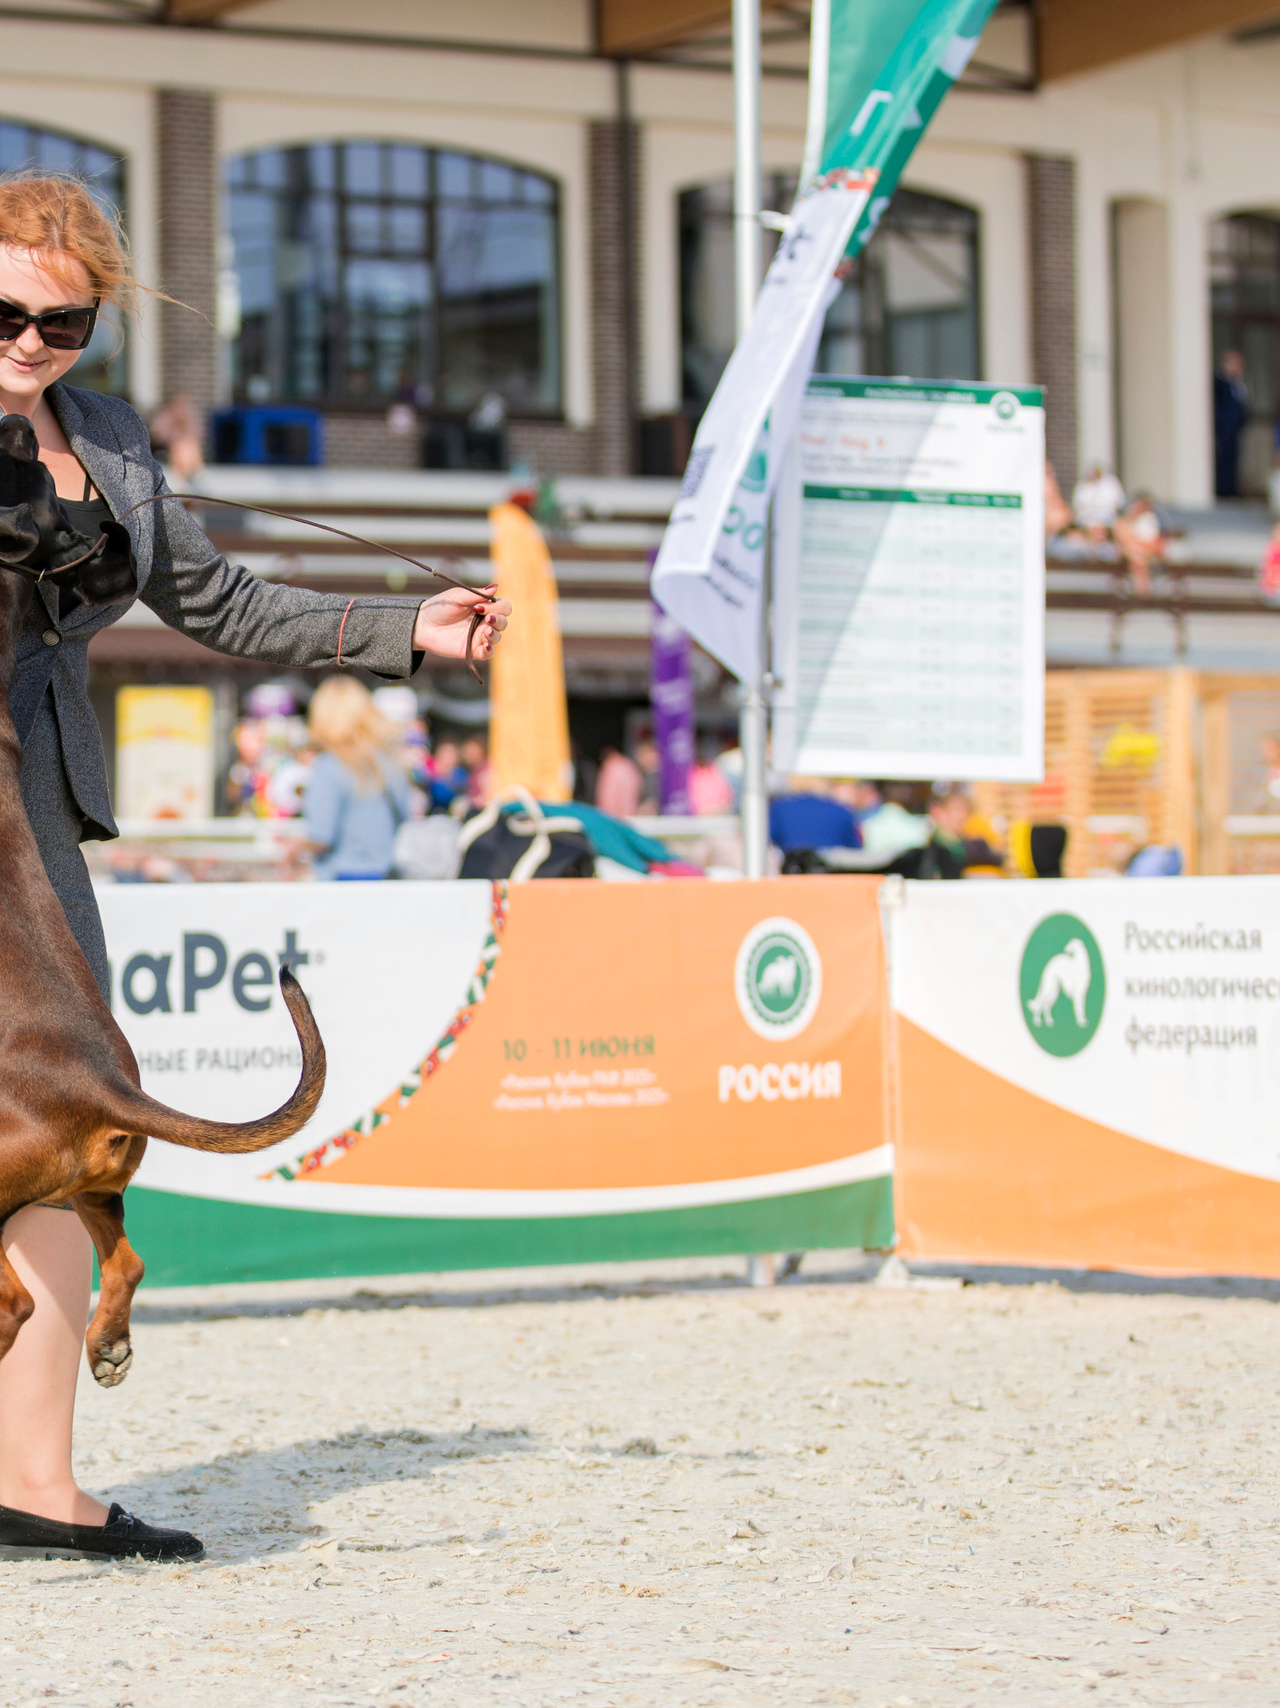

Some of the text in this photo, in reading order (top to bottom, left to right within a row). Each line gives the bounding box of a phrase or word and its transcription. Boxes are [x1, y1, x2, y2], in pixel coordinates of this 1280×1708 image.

[1125, 921, 1262, 950] Российская
[108, 929, 312, 1016] aPet
[1125, 977, 1280, 1000] кинологичес
[503, 1038, 527, 1061] 10
[553, 1037, 571, 1059] 11
[1125, 1014, 1257, 1056] федерация
[718, 1060, 841, 1103] РОССИЯ
